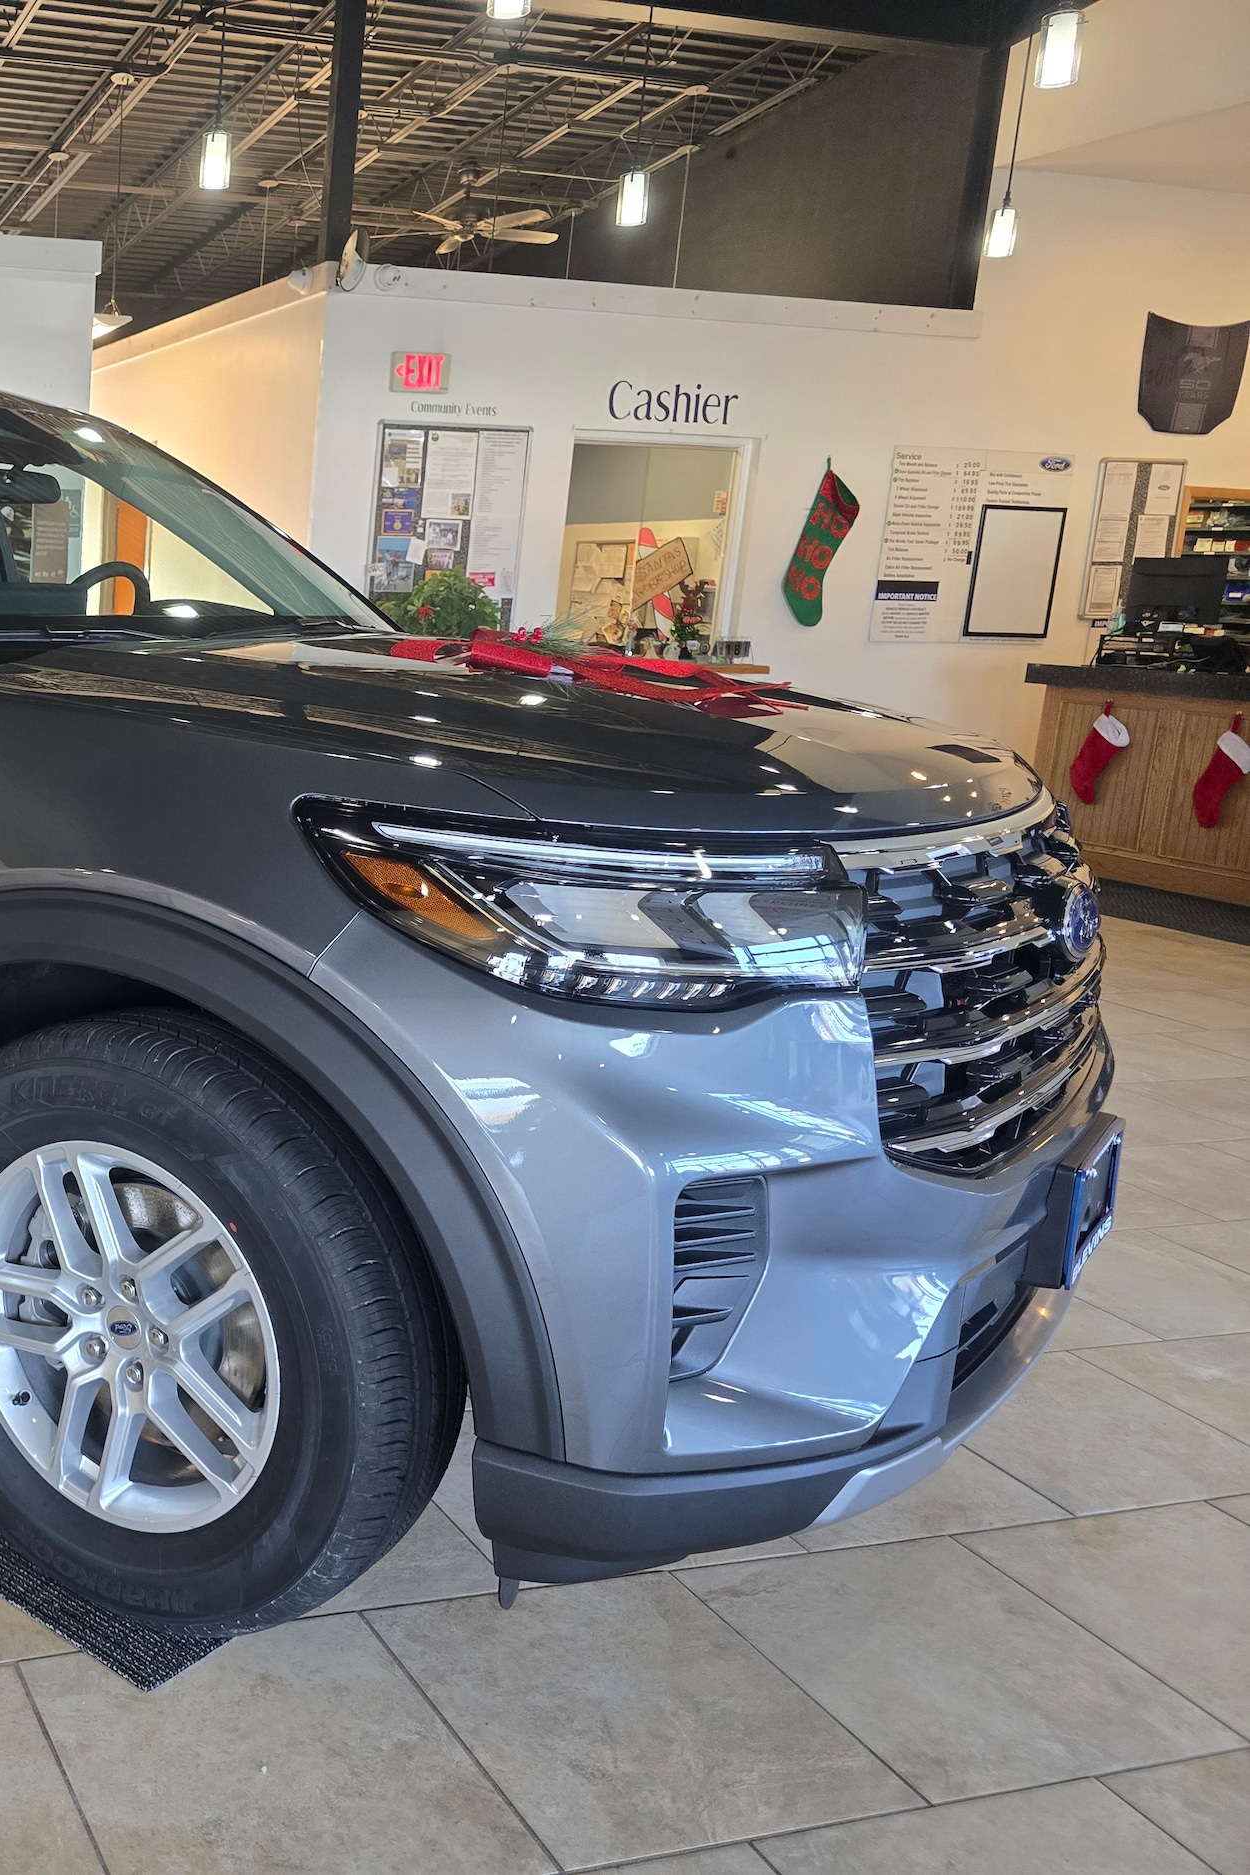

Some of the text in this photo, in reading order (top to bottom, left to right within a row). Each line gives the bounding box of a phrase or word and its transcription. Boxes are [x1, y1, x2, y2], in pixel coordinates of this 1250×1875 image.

[404, 353, 444, 389] EXIT
[1179, 379, 1211, 390] 50
[411, 401, 497, 416] Community Events
[609, 380, 739, 425] Cashier
[896, 452, 922, 460] Service
[810, 502, 850, 538] HO
[796, 534, 833, 569] HO
[634, 560, 686, 597] WORKSHOP
[786, 564, 820, 600] HO
[1072, 1216, 1112, 1284] BLEVINS
